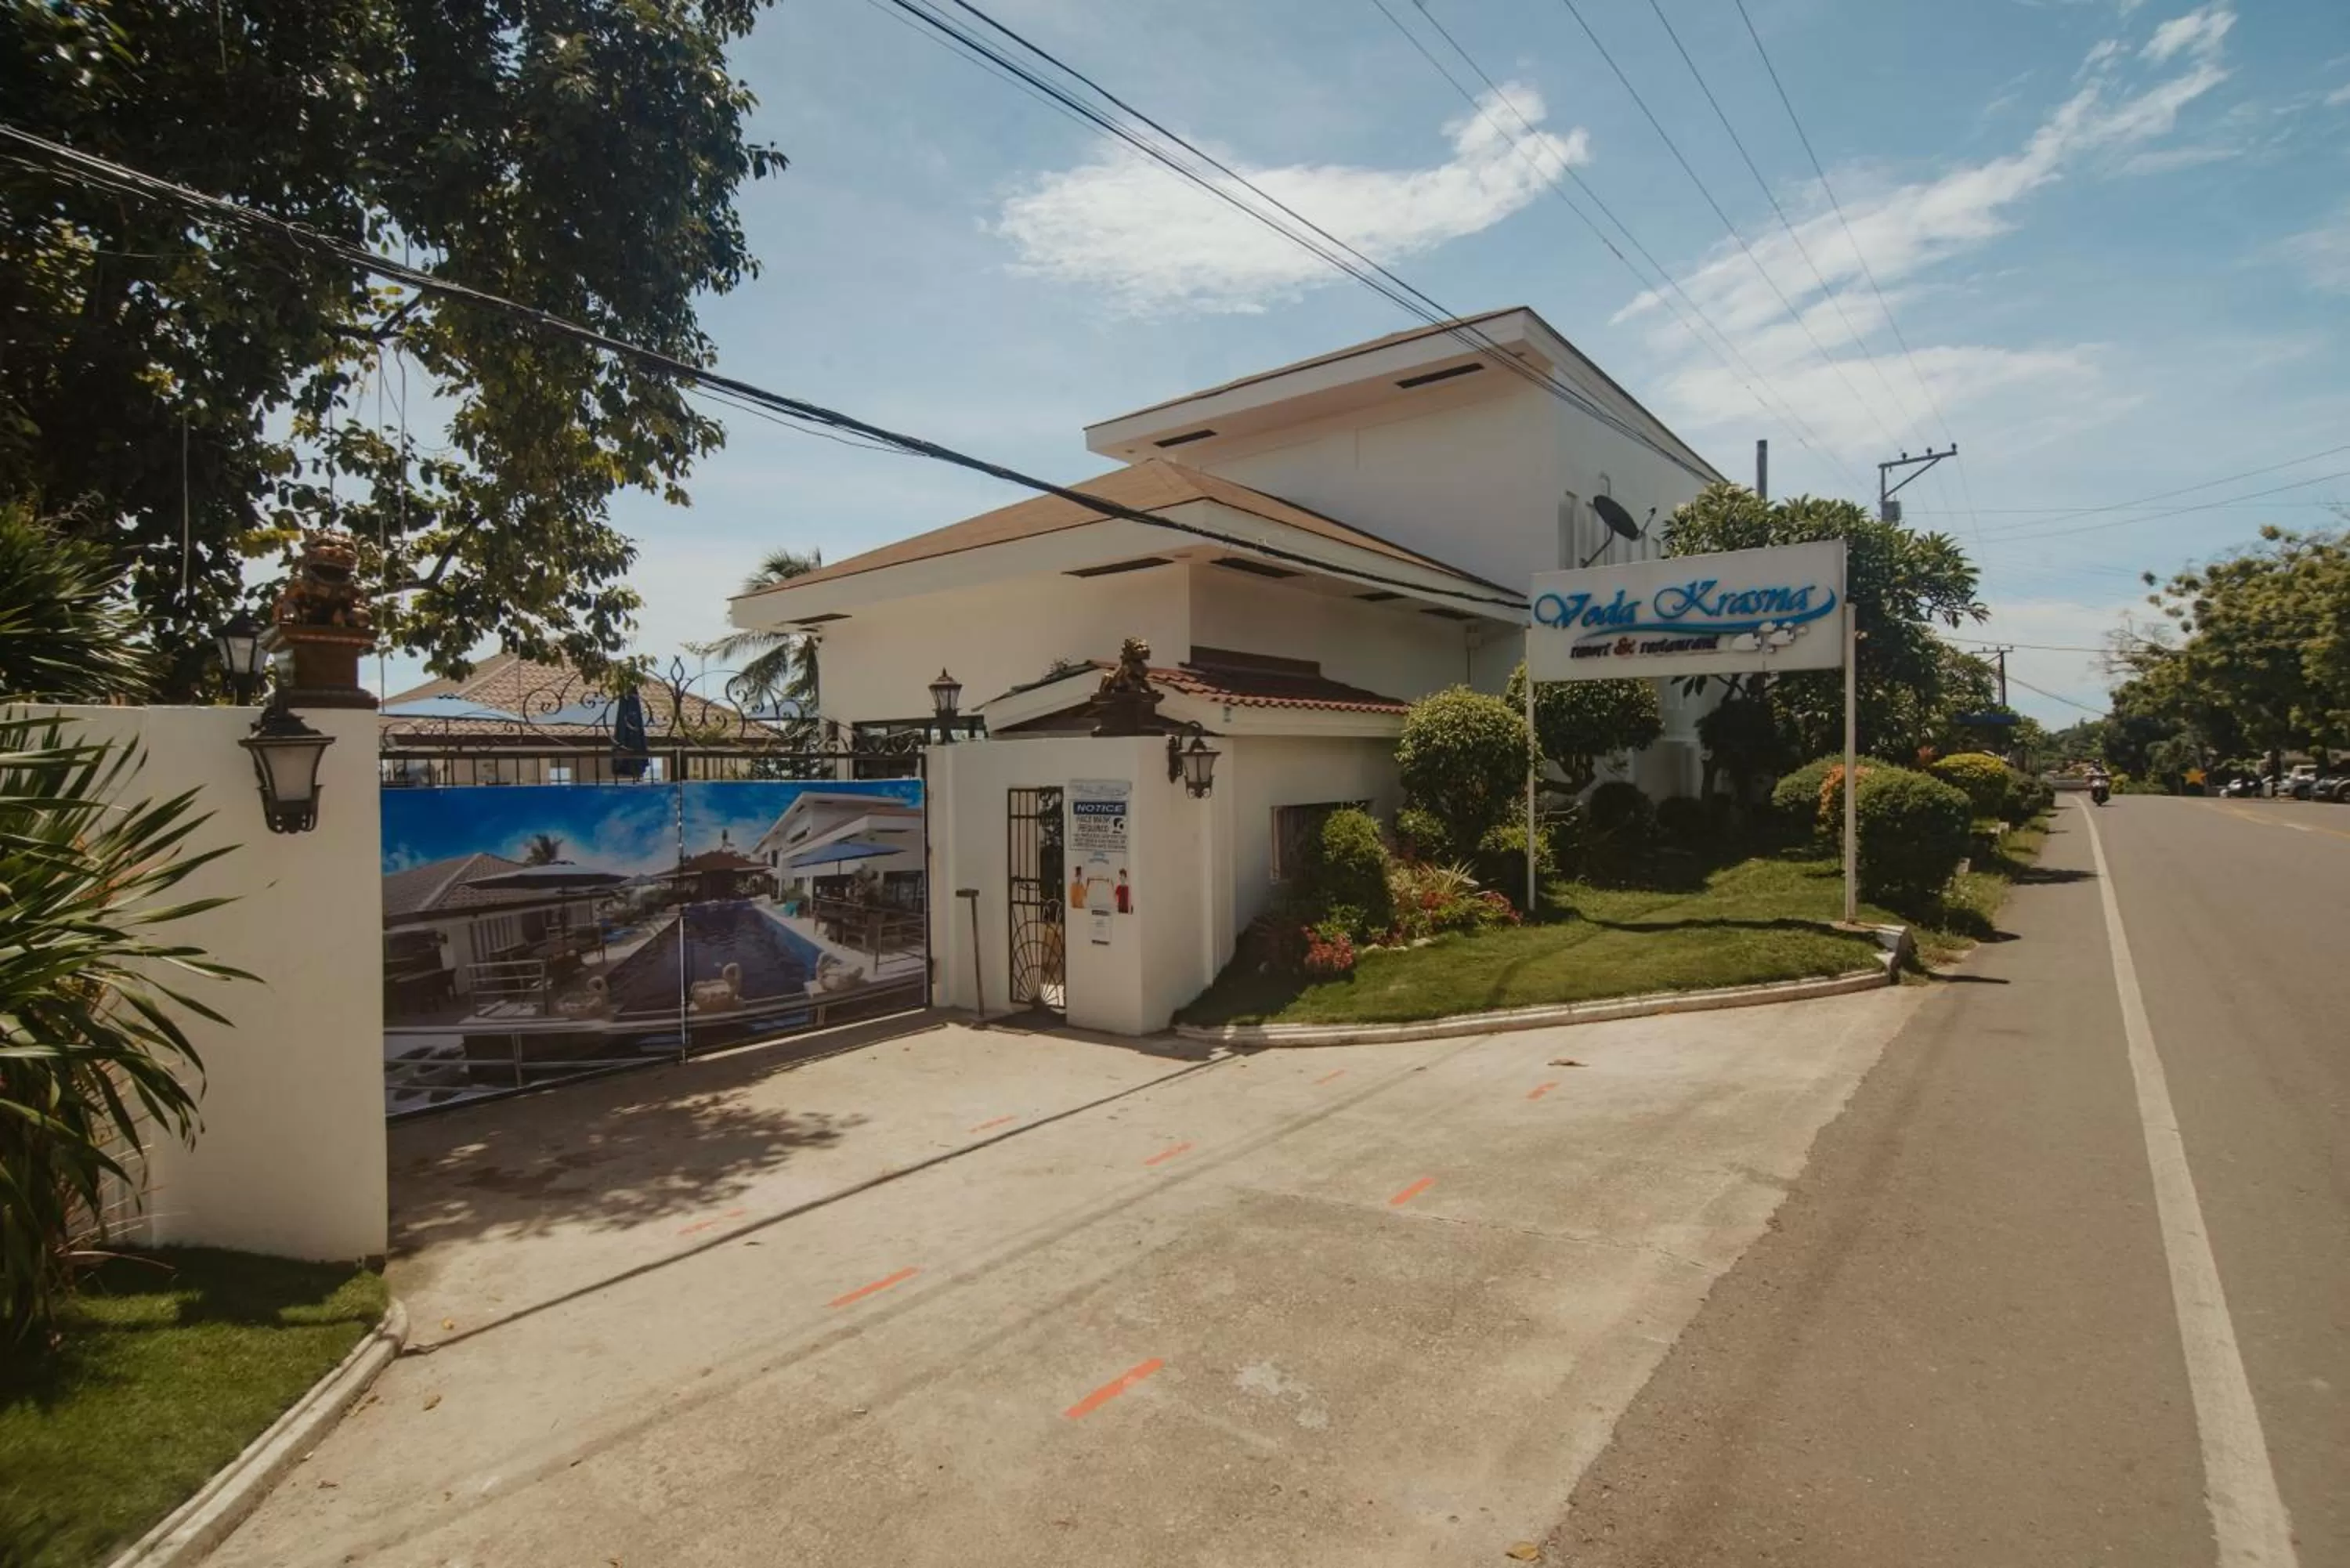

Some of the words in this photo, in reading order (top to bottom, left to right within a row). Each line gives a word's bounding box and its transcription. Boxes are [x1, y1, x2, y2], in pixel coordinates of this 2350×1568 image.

[1534, 589, 1642, 628] Voda
[1654, 580, 1816, 620] Krasna
[1614, 636, 1635, 656] &
[1639, 634, 1720, 655] restaurant
[1077, 804, 1123, 813] NOTICE
